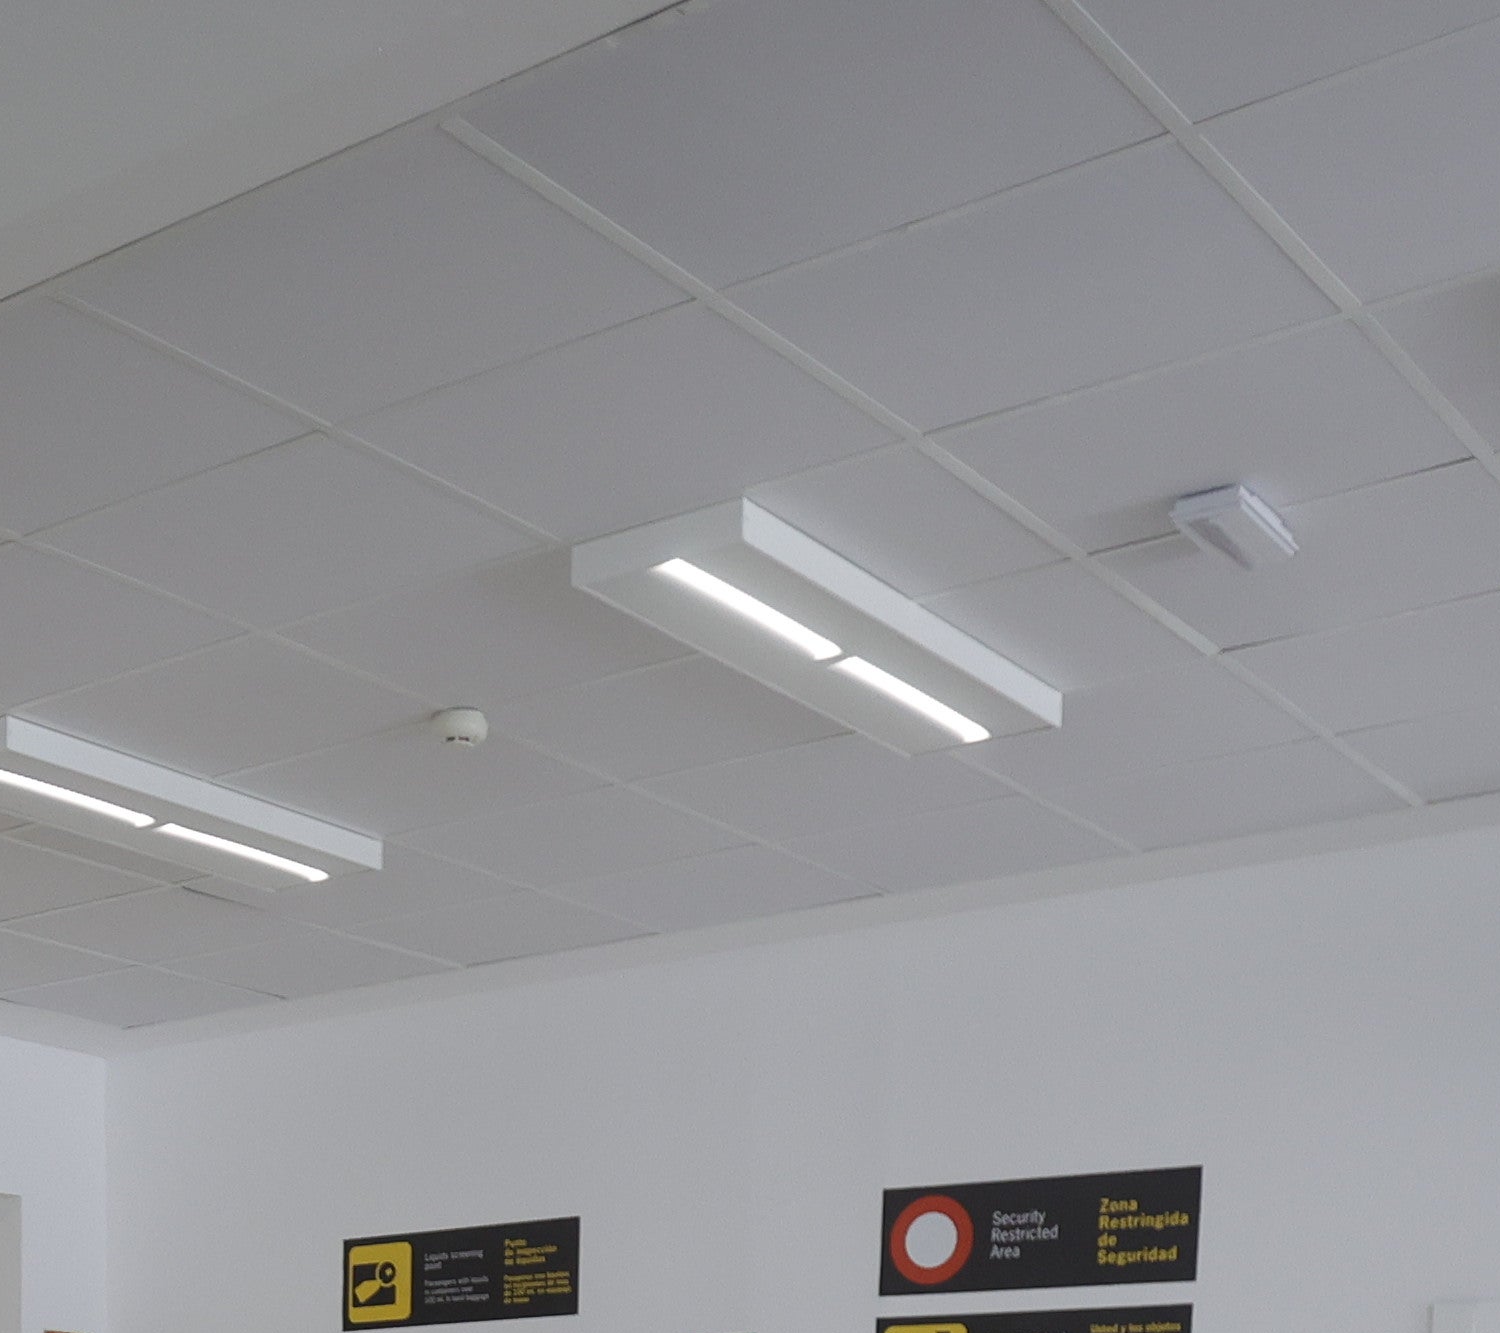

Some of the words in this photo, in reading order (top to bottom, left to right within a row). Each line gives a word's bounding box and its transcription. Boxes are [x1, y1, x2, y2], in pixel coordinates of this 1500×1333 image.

[1100, 1198, 1139, 1213] Zona
[992, 1209, 1046, 1226] Security
[1098, 1211, 1190, 1230] Restringida
[990, 1224, 1059, 1243] Restricted
[1097, 1233, 1118, 1247] de
[989, 1244, 1021, 1260] Area
[1097, 1245, 1178, 1266] Seguridad
